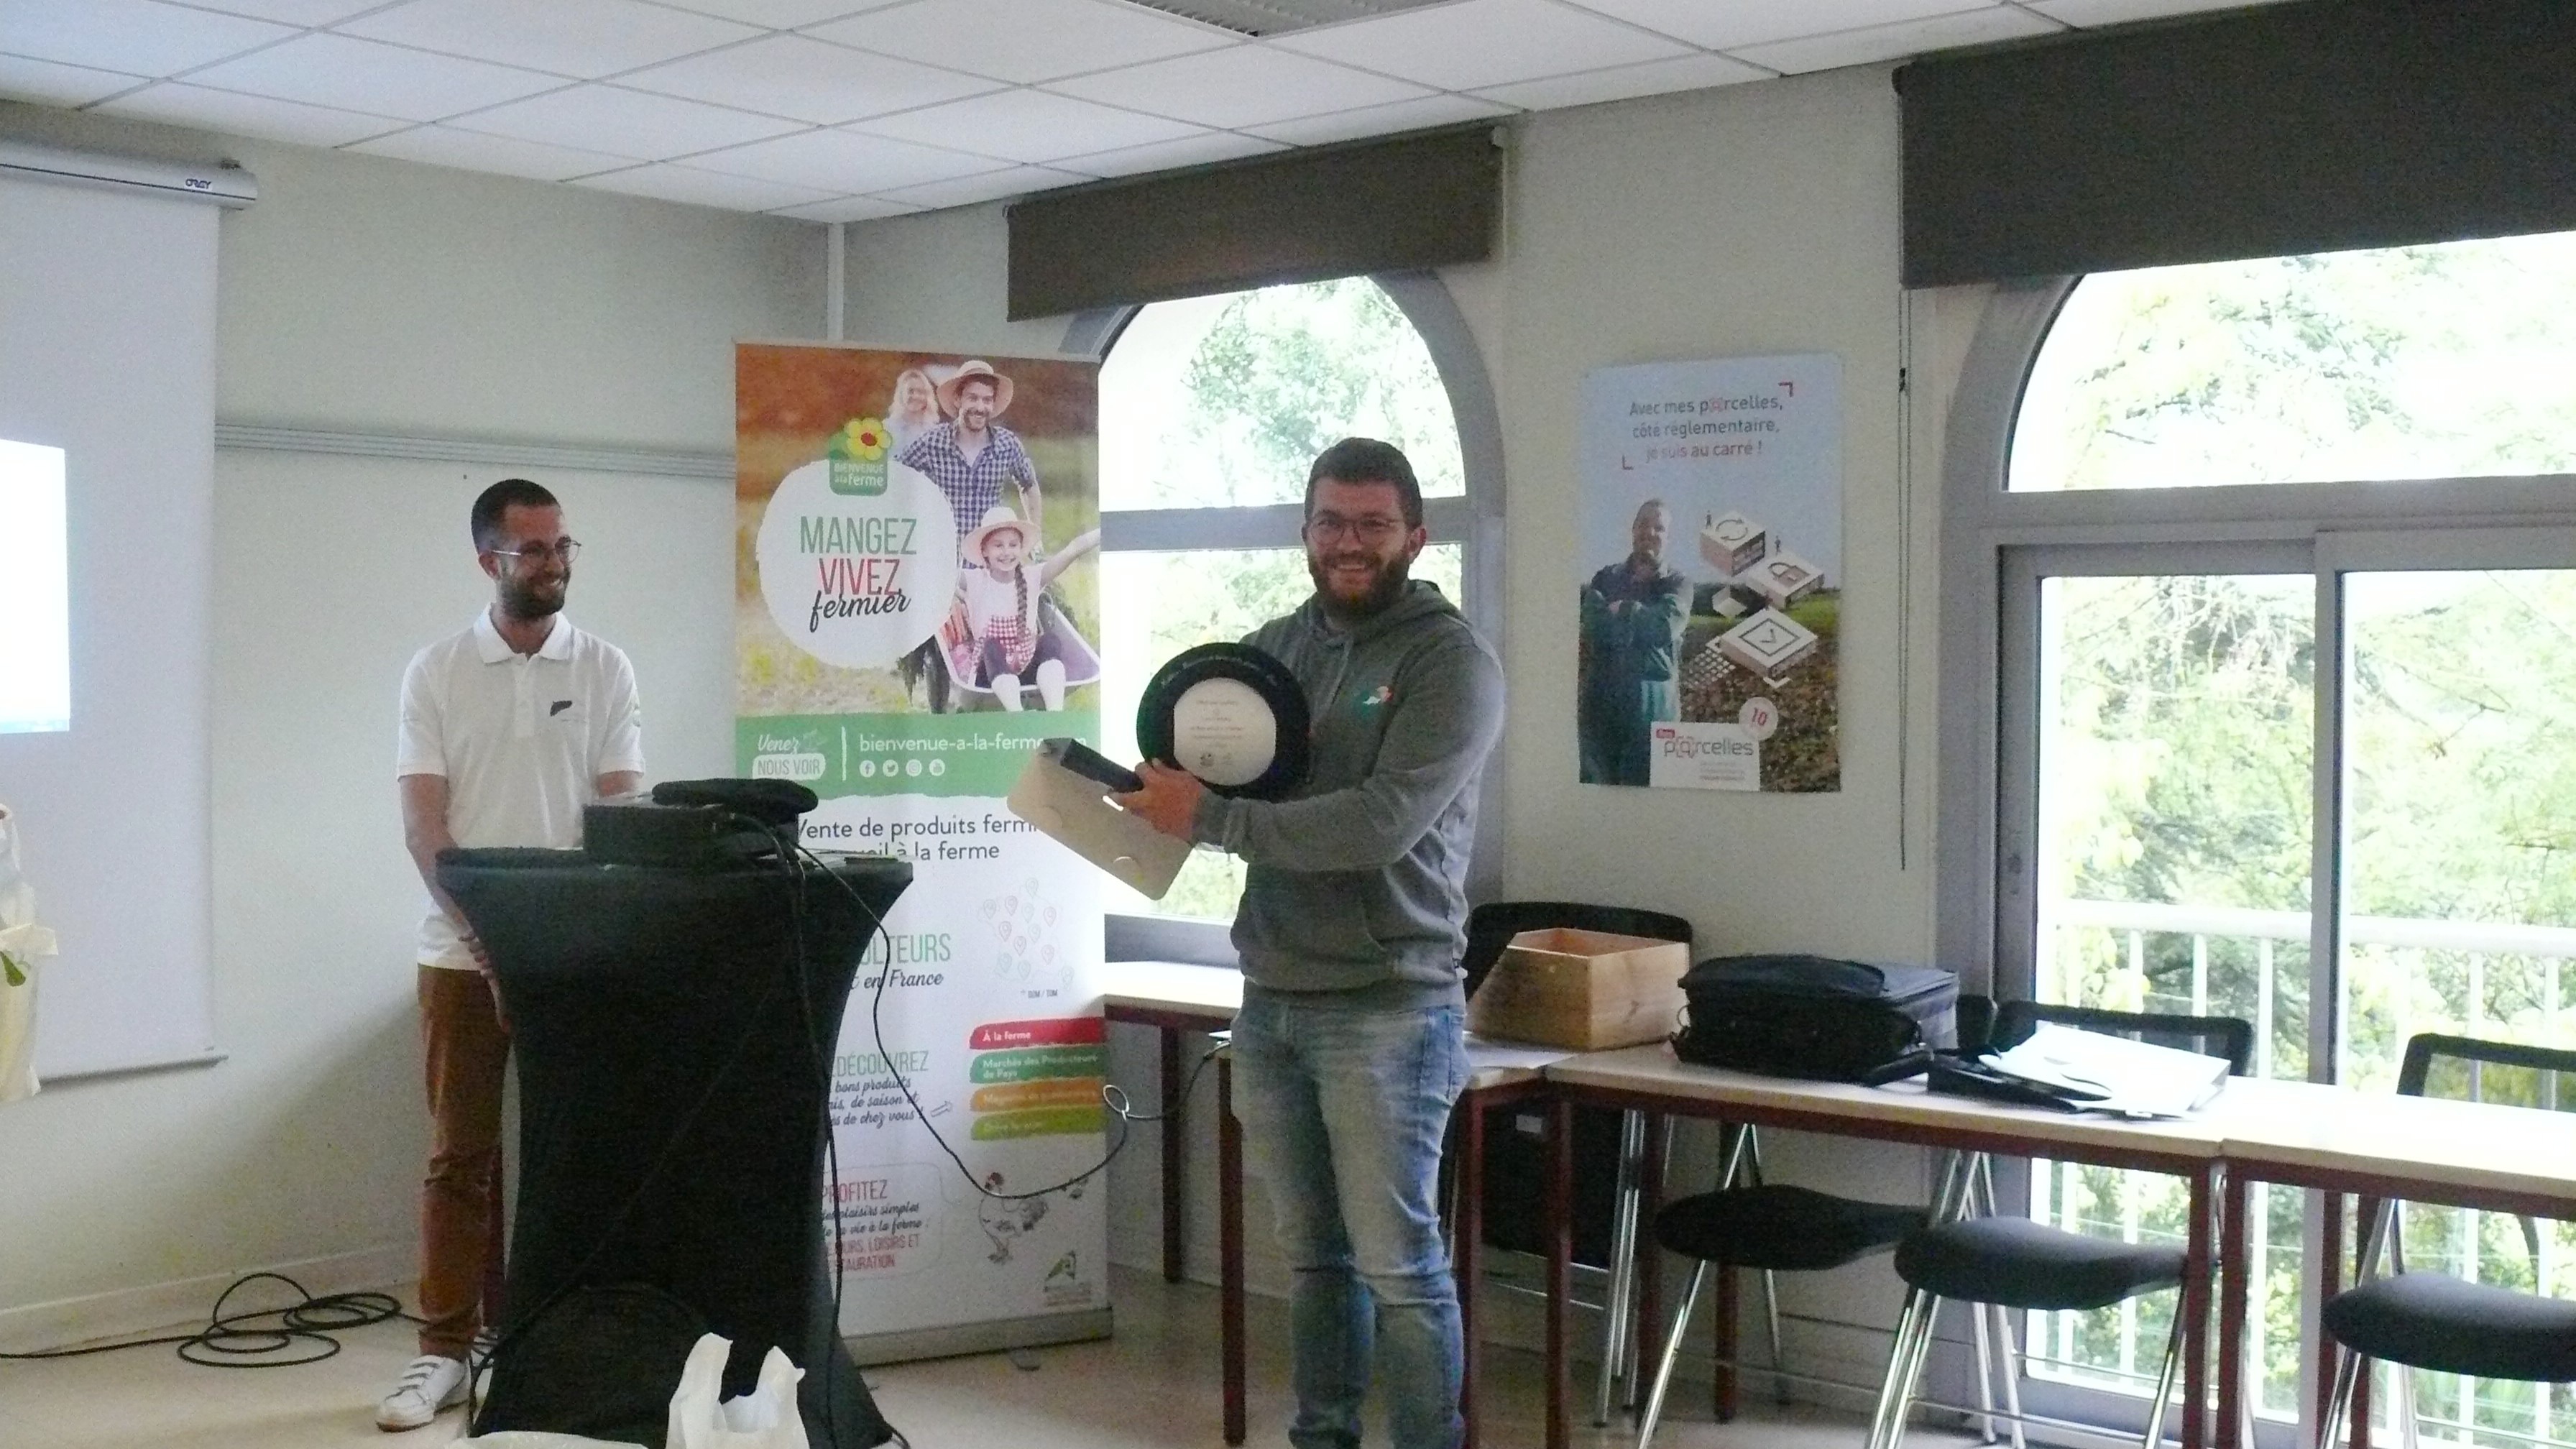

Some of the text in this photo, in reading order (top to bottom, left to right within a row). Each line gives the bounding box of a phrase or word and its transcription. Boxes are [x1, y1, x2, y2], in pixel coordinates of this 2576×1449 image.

[1629, 401, 1661, 416] Avec
[1664, 400, 1695, 414] mes
[1632, 422, 1660, 438] côté
[1645, 446, 1658, 464] je
[1661, 443, 1688, 459] suis
[1690, 446, 1709, 457] au
[1712, 439, 1753, 457] carré
[834, 462, 884, 474] BIENVENUE
[848, 473, 884, 487] ferme
[801, 515, 917, 556] MANGEZ
[819, 558, 900, 596] VIVEZ
[810, 586, 911, 632] fermier
[1752, 707, 1767, 727] 10
[758, 733, 800, 755] Venez
[758, 759, 791, 776] NOUS
[859, 816, 884, 837] de
[891, 814, 977, 842] produits
[914, 841, 931, 861] la
[938, 840, 1000, 860] ferme
[863, 975, 886, 989] en
[888, 969, 944, 988] France
[983, 1030, 1031, 1042] À la ferme
[836, 1050, 929, 1077] DÉCOUVREZ
[834, 1080, 860, 1093] bons
[850, 1095, 865, 1108] de
[867, 1092, 903, 1108] saison
[842, 1112, 857, 1126] de
[860, 1110, 886, 1130] chez
[888, 1110, 915, 1122] vous
[879, 1200, 920, 1217] simples
[879, 1219, 890, 1231] la
[891, 1217, 923, 1236] ferme
[908, 1233, 921, 1248] ET
